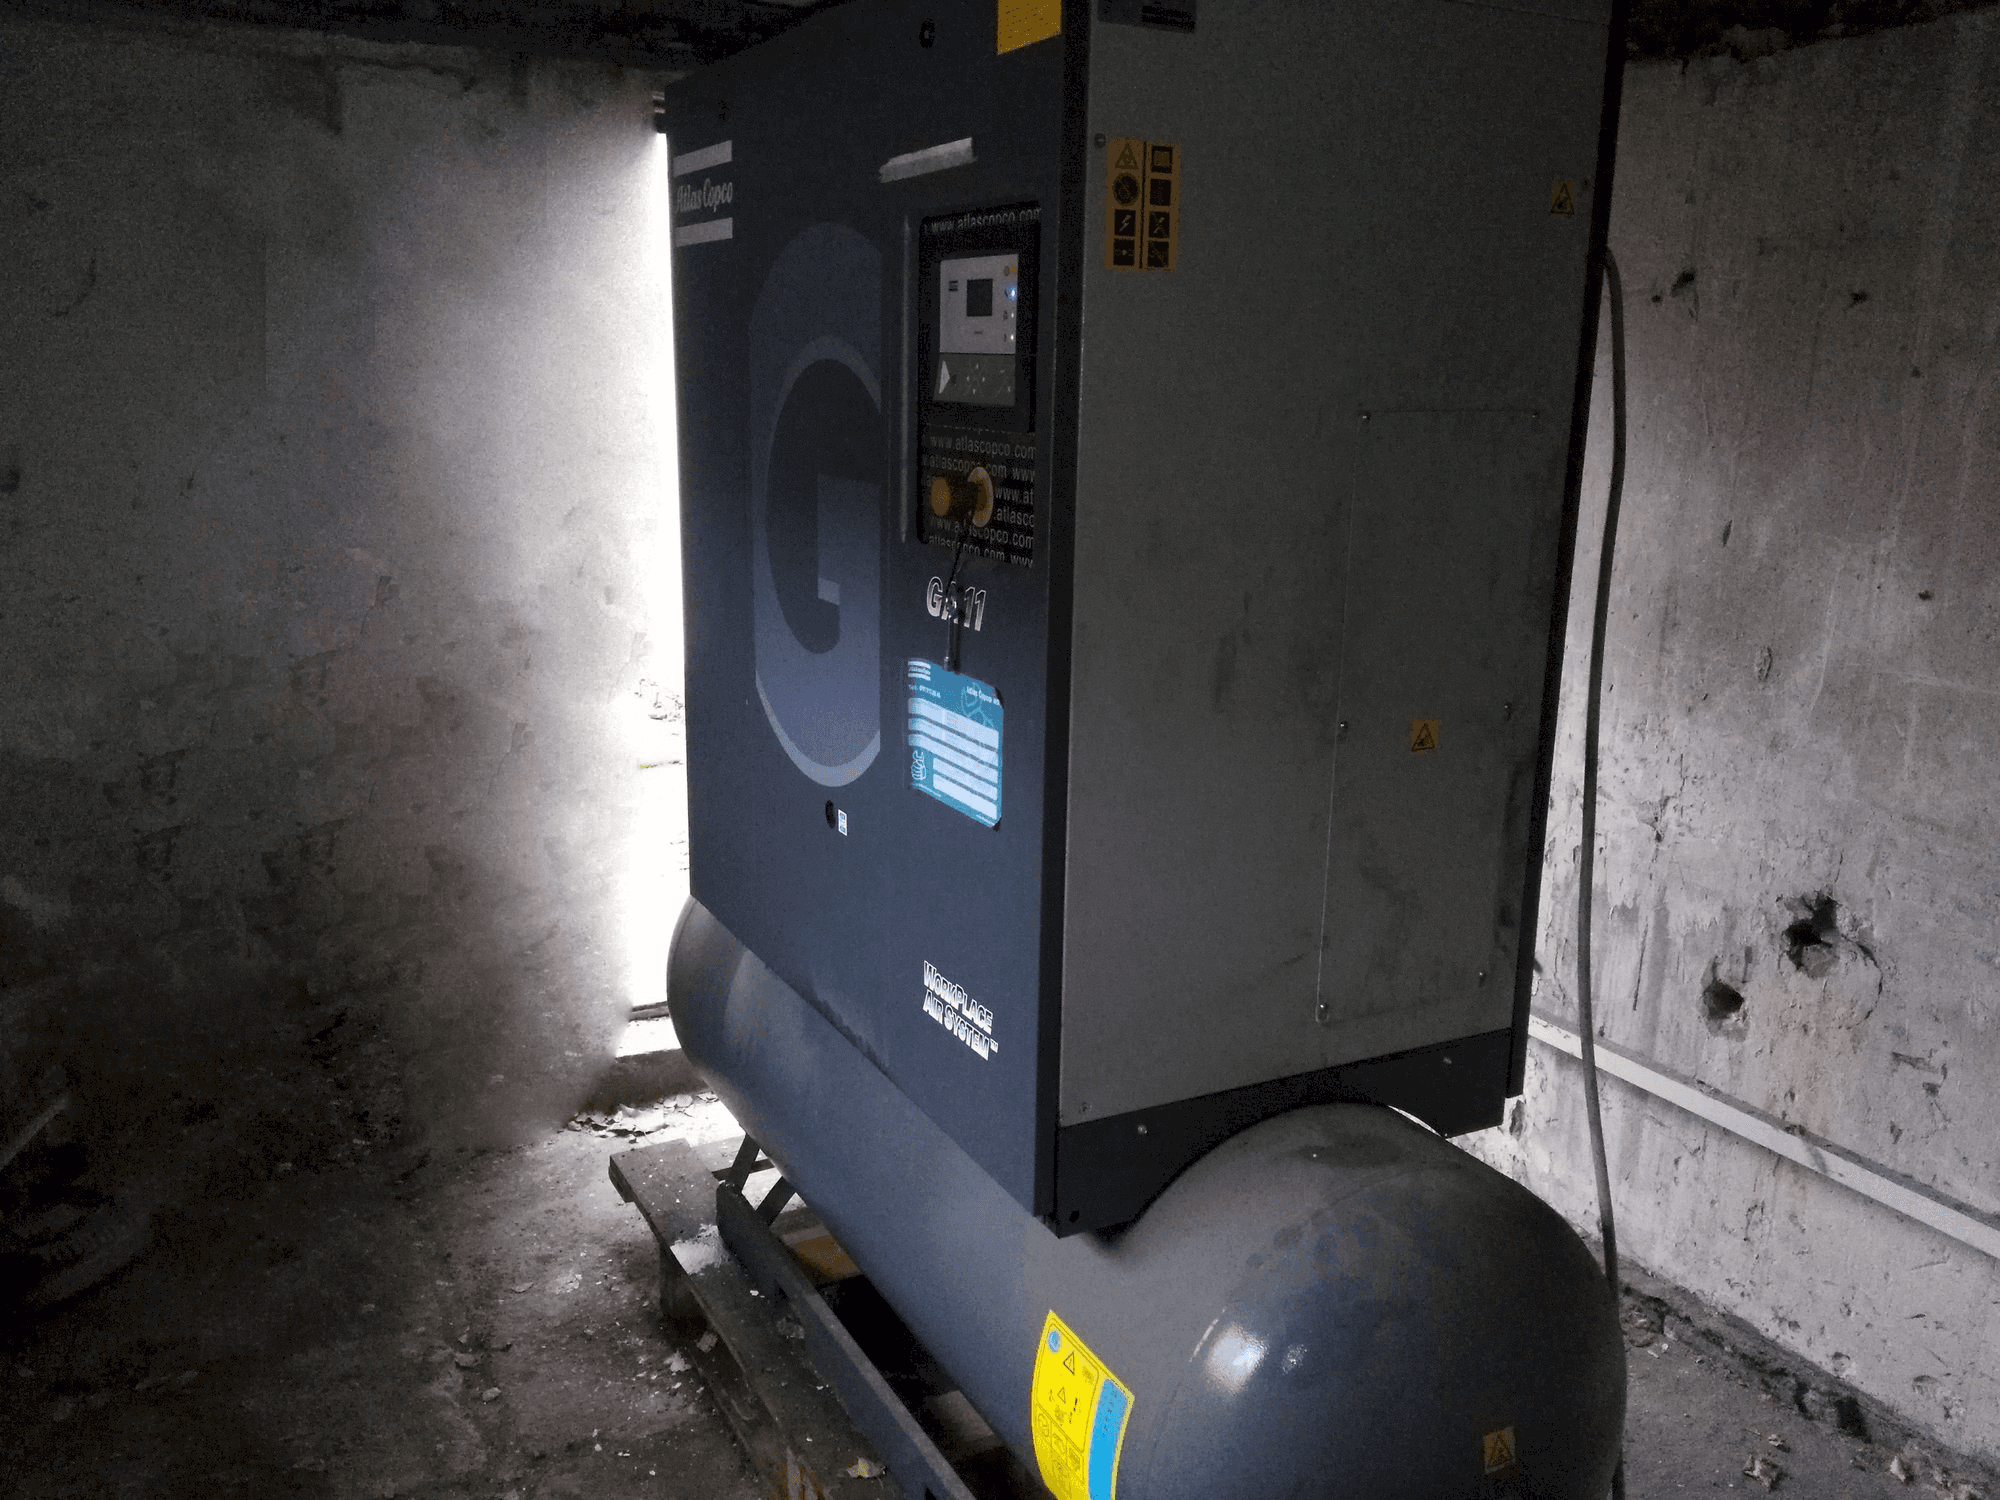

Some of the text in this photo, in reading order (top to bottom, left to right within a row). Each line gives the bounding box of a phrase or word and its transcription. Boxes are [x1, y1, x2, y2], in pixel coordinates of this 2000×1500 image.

[675, 178, 734, 214] Atlas Copco
[963, 586, 987, 632] 11
[923, 989, 944, 1025] AIR
